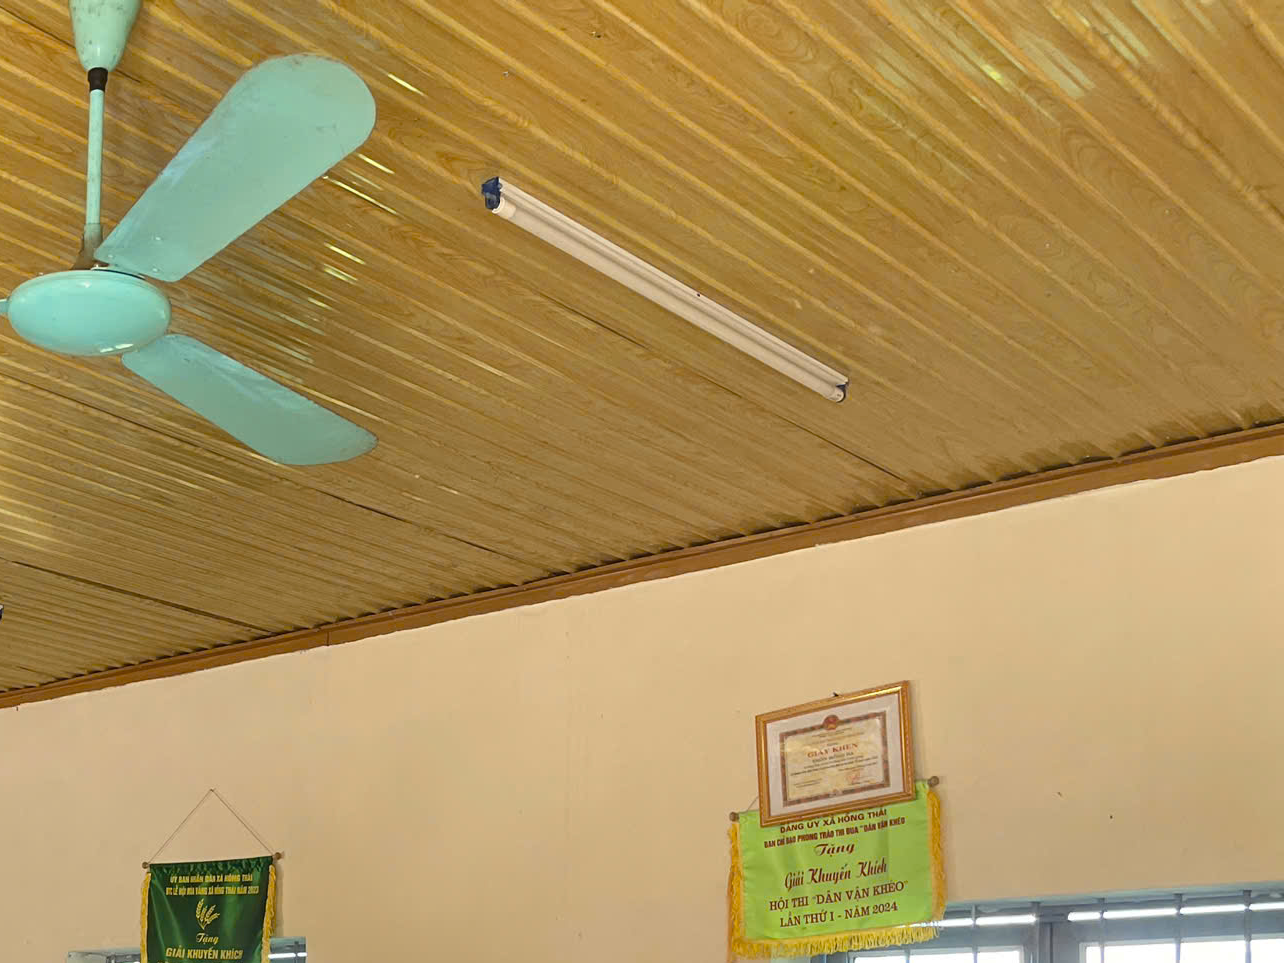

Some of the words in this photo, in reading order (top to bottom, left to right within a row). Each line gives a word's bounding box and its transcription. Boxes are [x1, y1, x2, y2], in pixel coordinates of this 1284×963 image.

[815, 843, 855, 857] Tặng
[807, 864, 851, 885] Khuyến
[769, 897, 788, 912] HỘI
[791, 896, 808, 908] THI
[846, 885, 869, 902] VẬN
[780, 911, 800, 927] LẦN
[803, 909, 828, 924] THỨ
[844, 904, 870, 919] NĂM
[872, 901, 898, 914] 2024
[196, 933, 219, 945] Tặng
